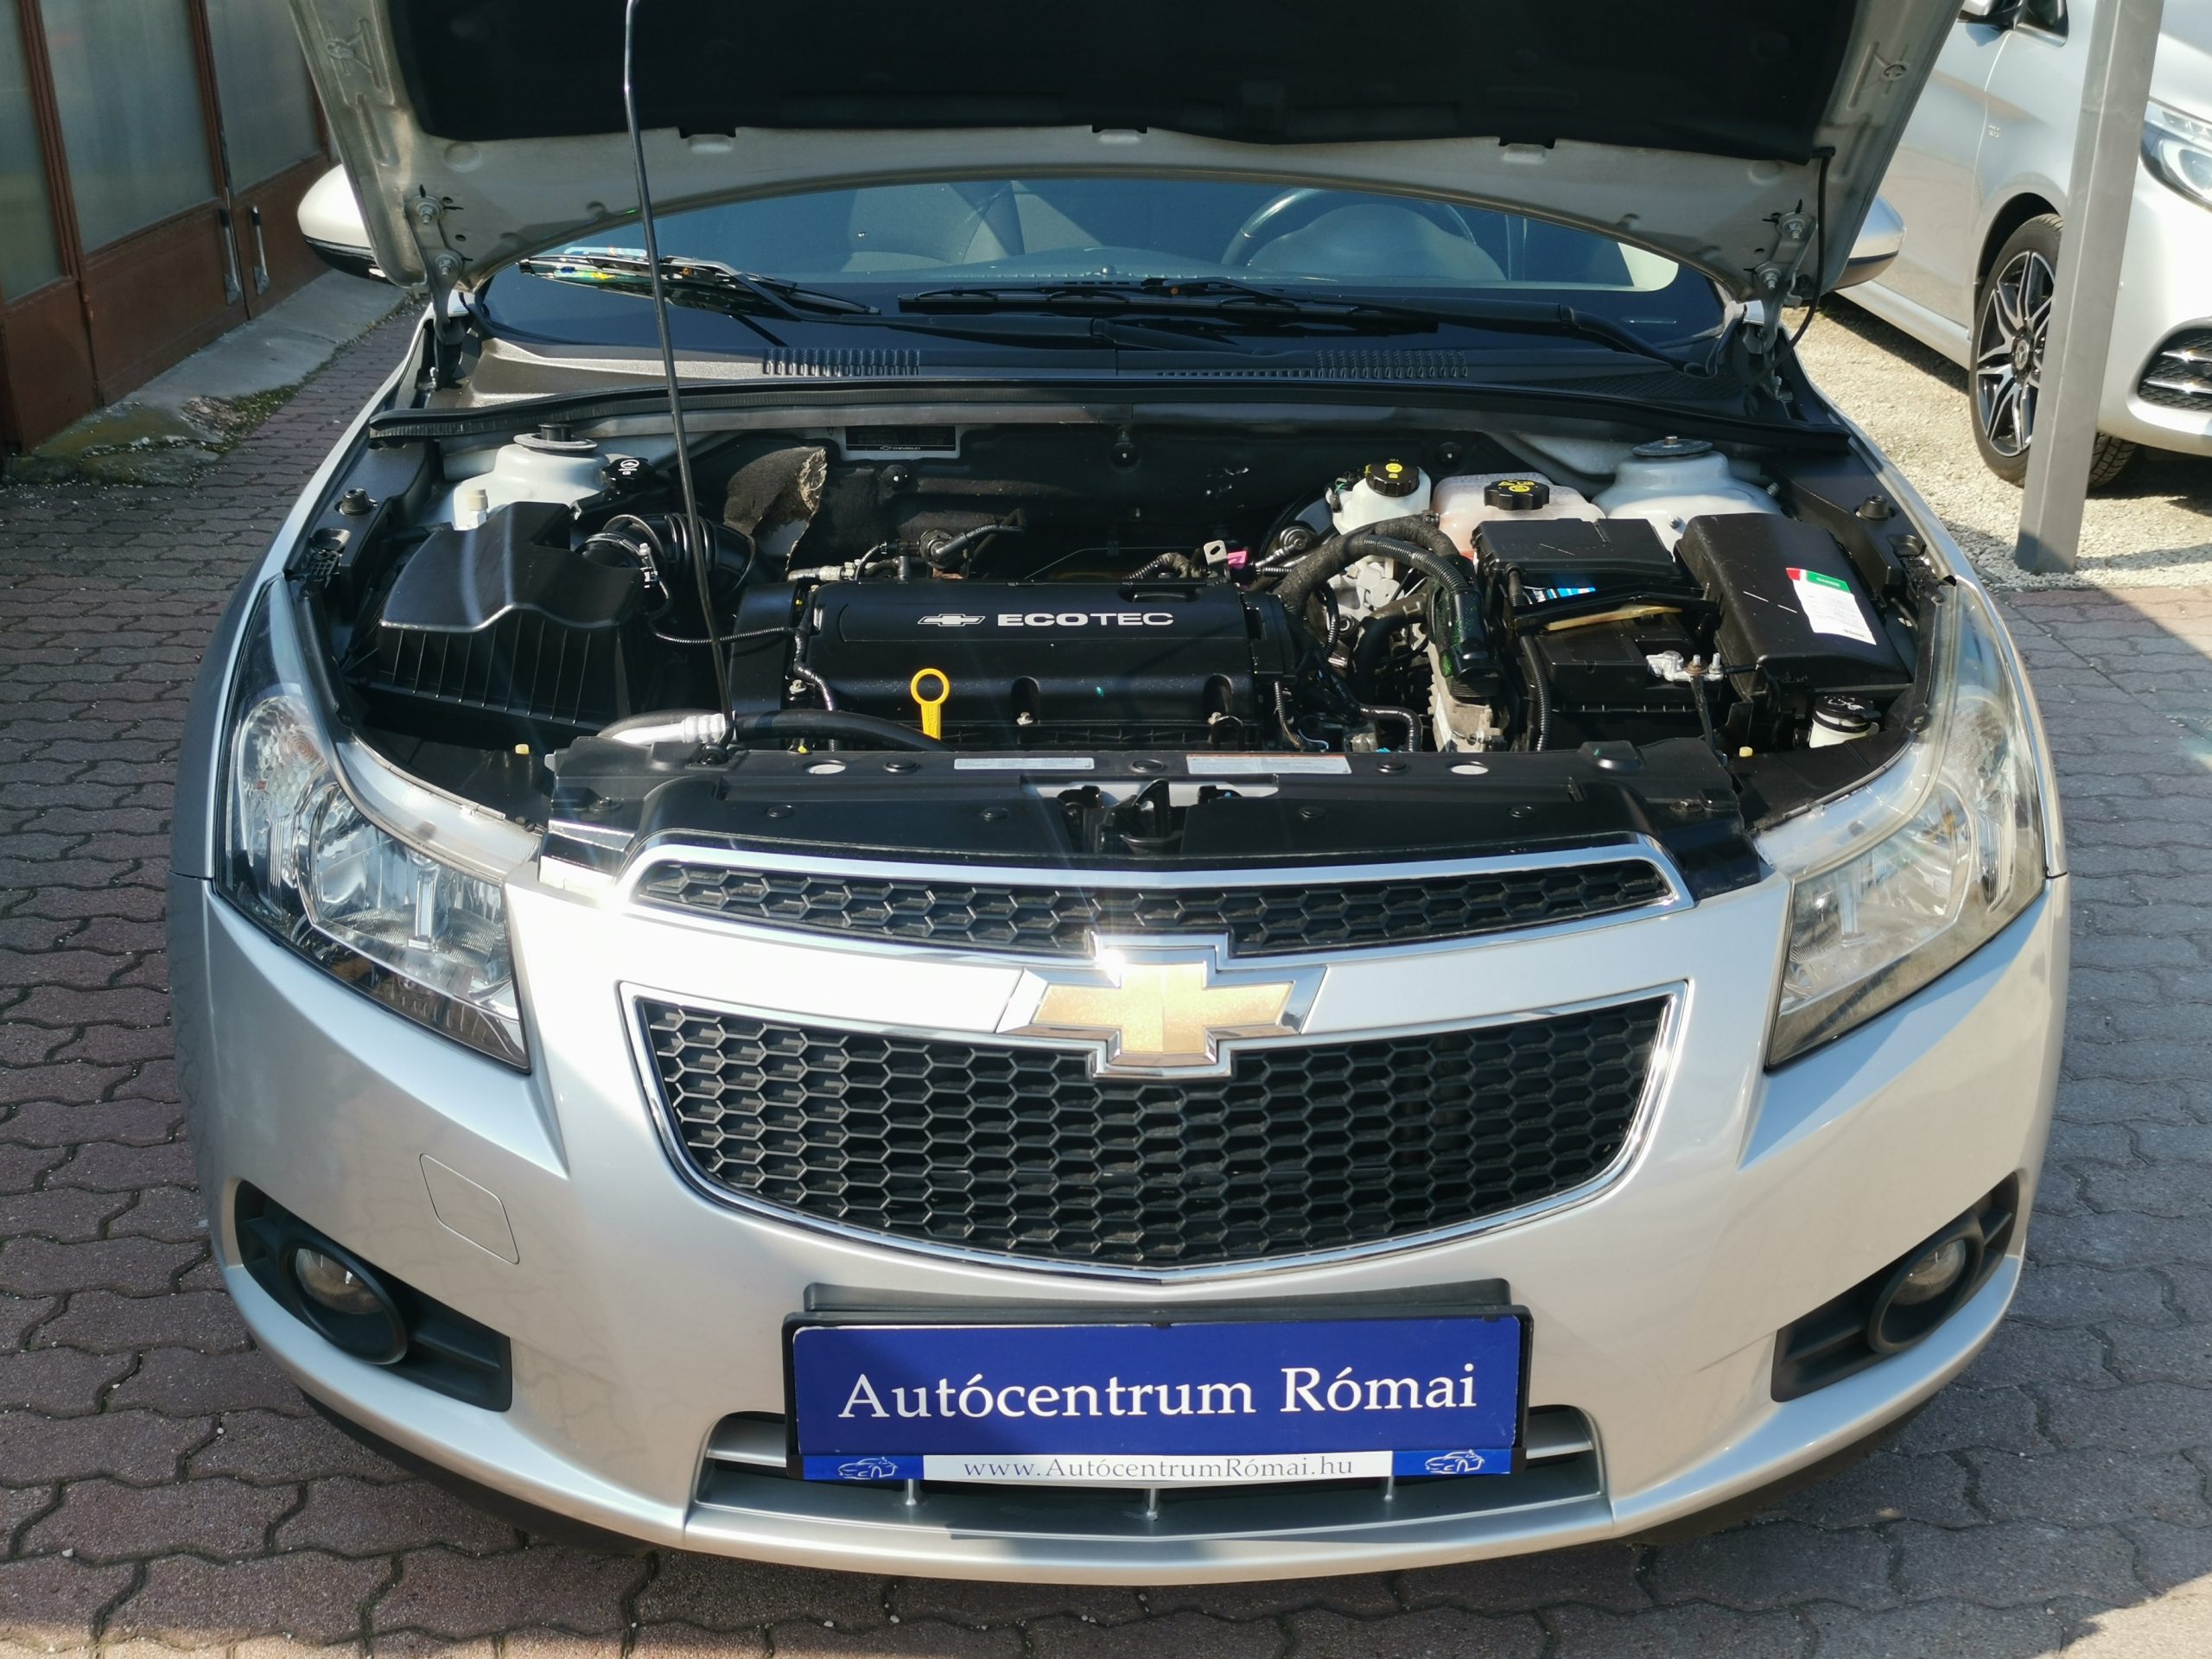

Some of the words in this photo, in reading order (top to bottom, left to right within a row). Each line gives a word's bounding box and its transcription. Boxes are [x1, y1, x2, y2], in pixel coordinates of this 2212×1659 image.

[997, 612, 1174, 626] ECOTEC
[837, 1373, 1256, 1418] Autócentrum
[1280, 1363, 1477, 1413] Római
[963, 1457, 1354, 1478] www.AutócentrumRómai.hu
